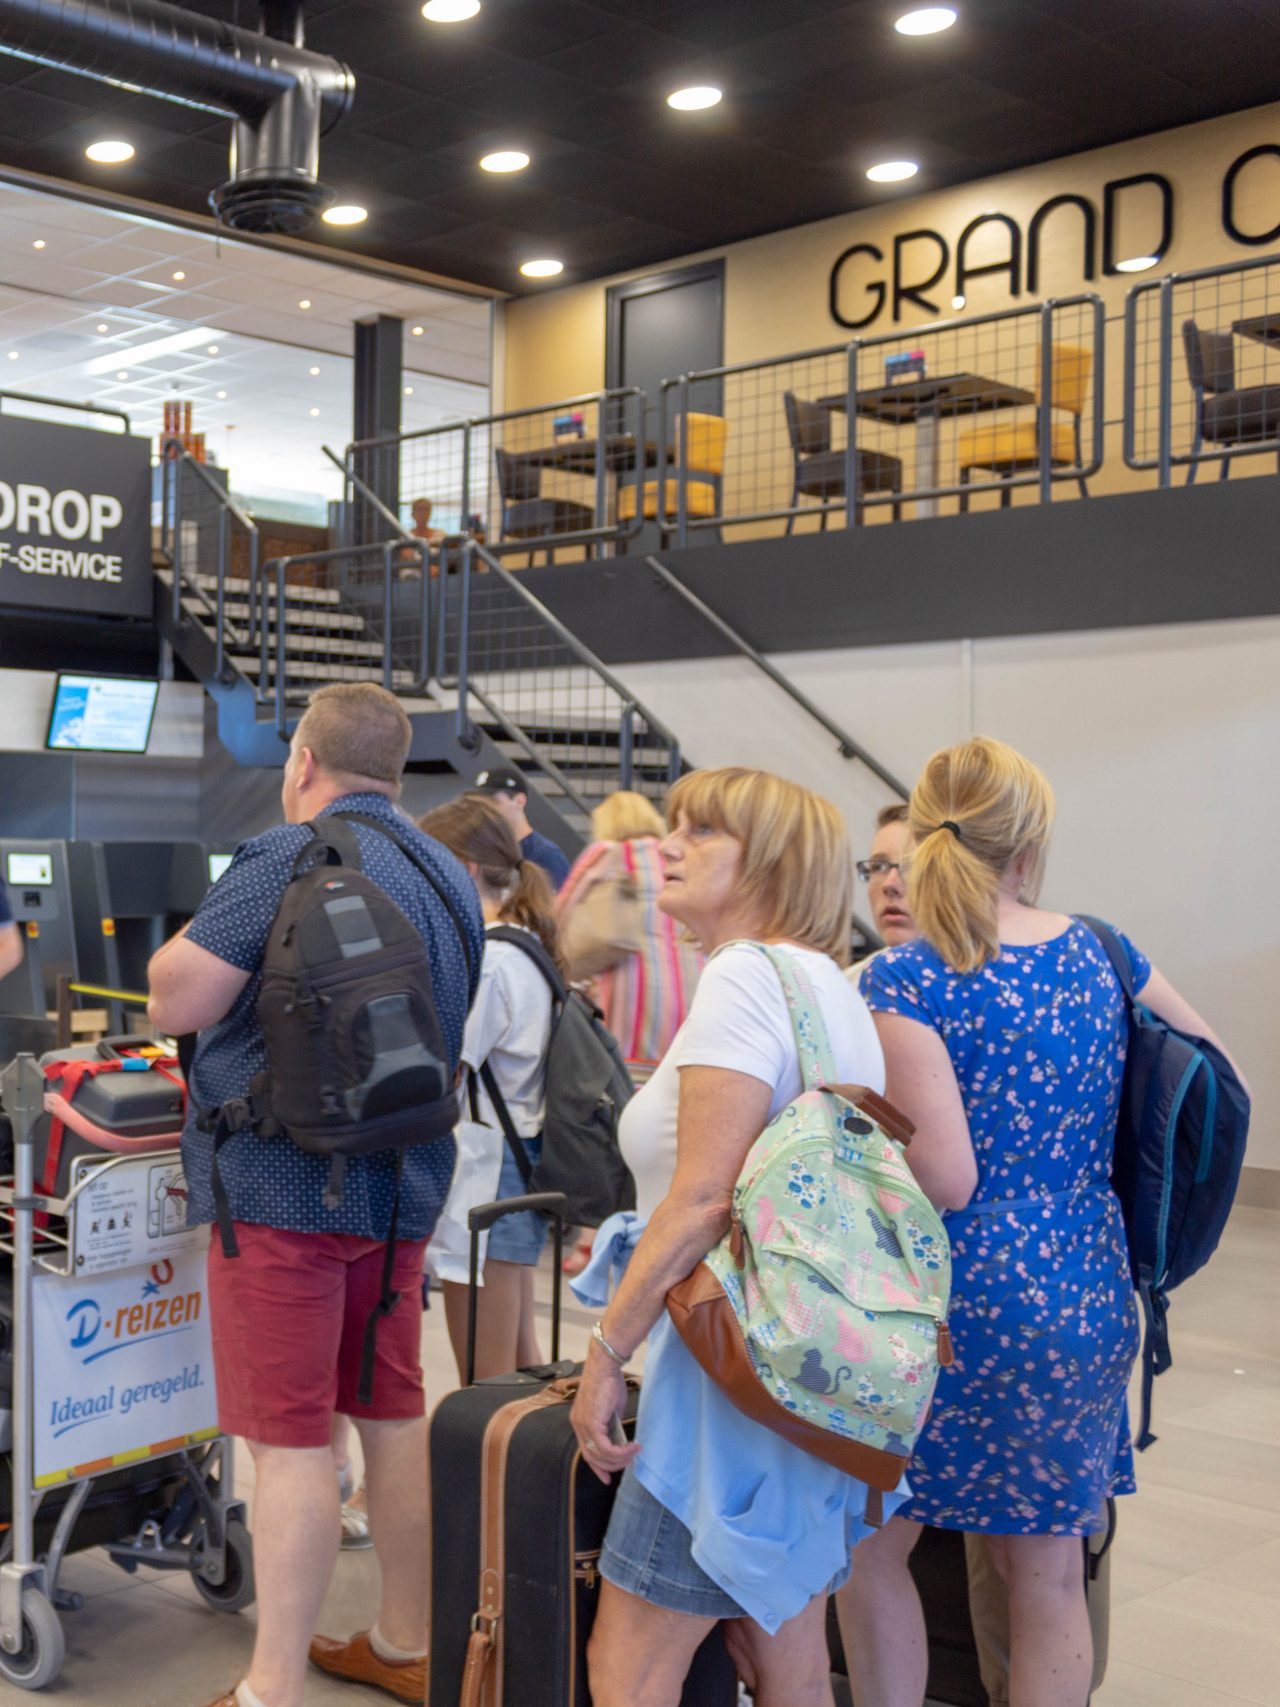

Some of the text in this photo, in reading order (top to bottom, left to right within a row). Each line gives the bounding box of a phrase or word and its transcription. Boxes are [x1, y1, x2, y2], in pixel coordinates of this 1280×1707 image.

[829, 173, 1175, 329] GRAND
[49, 1364, 205, 1426] Ideaal geregeld.
